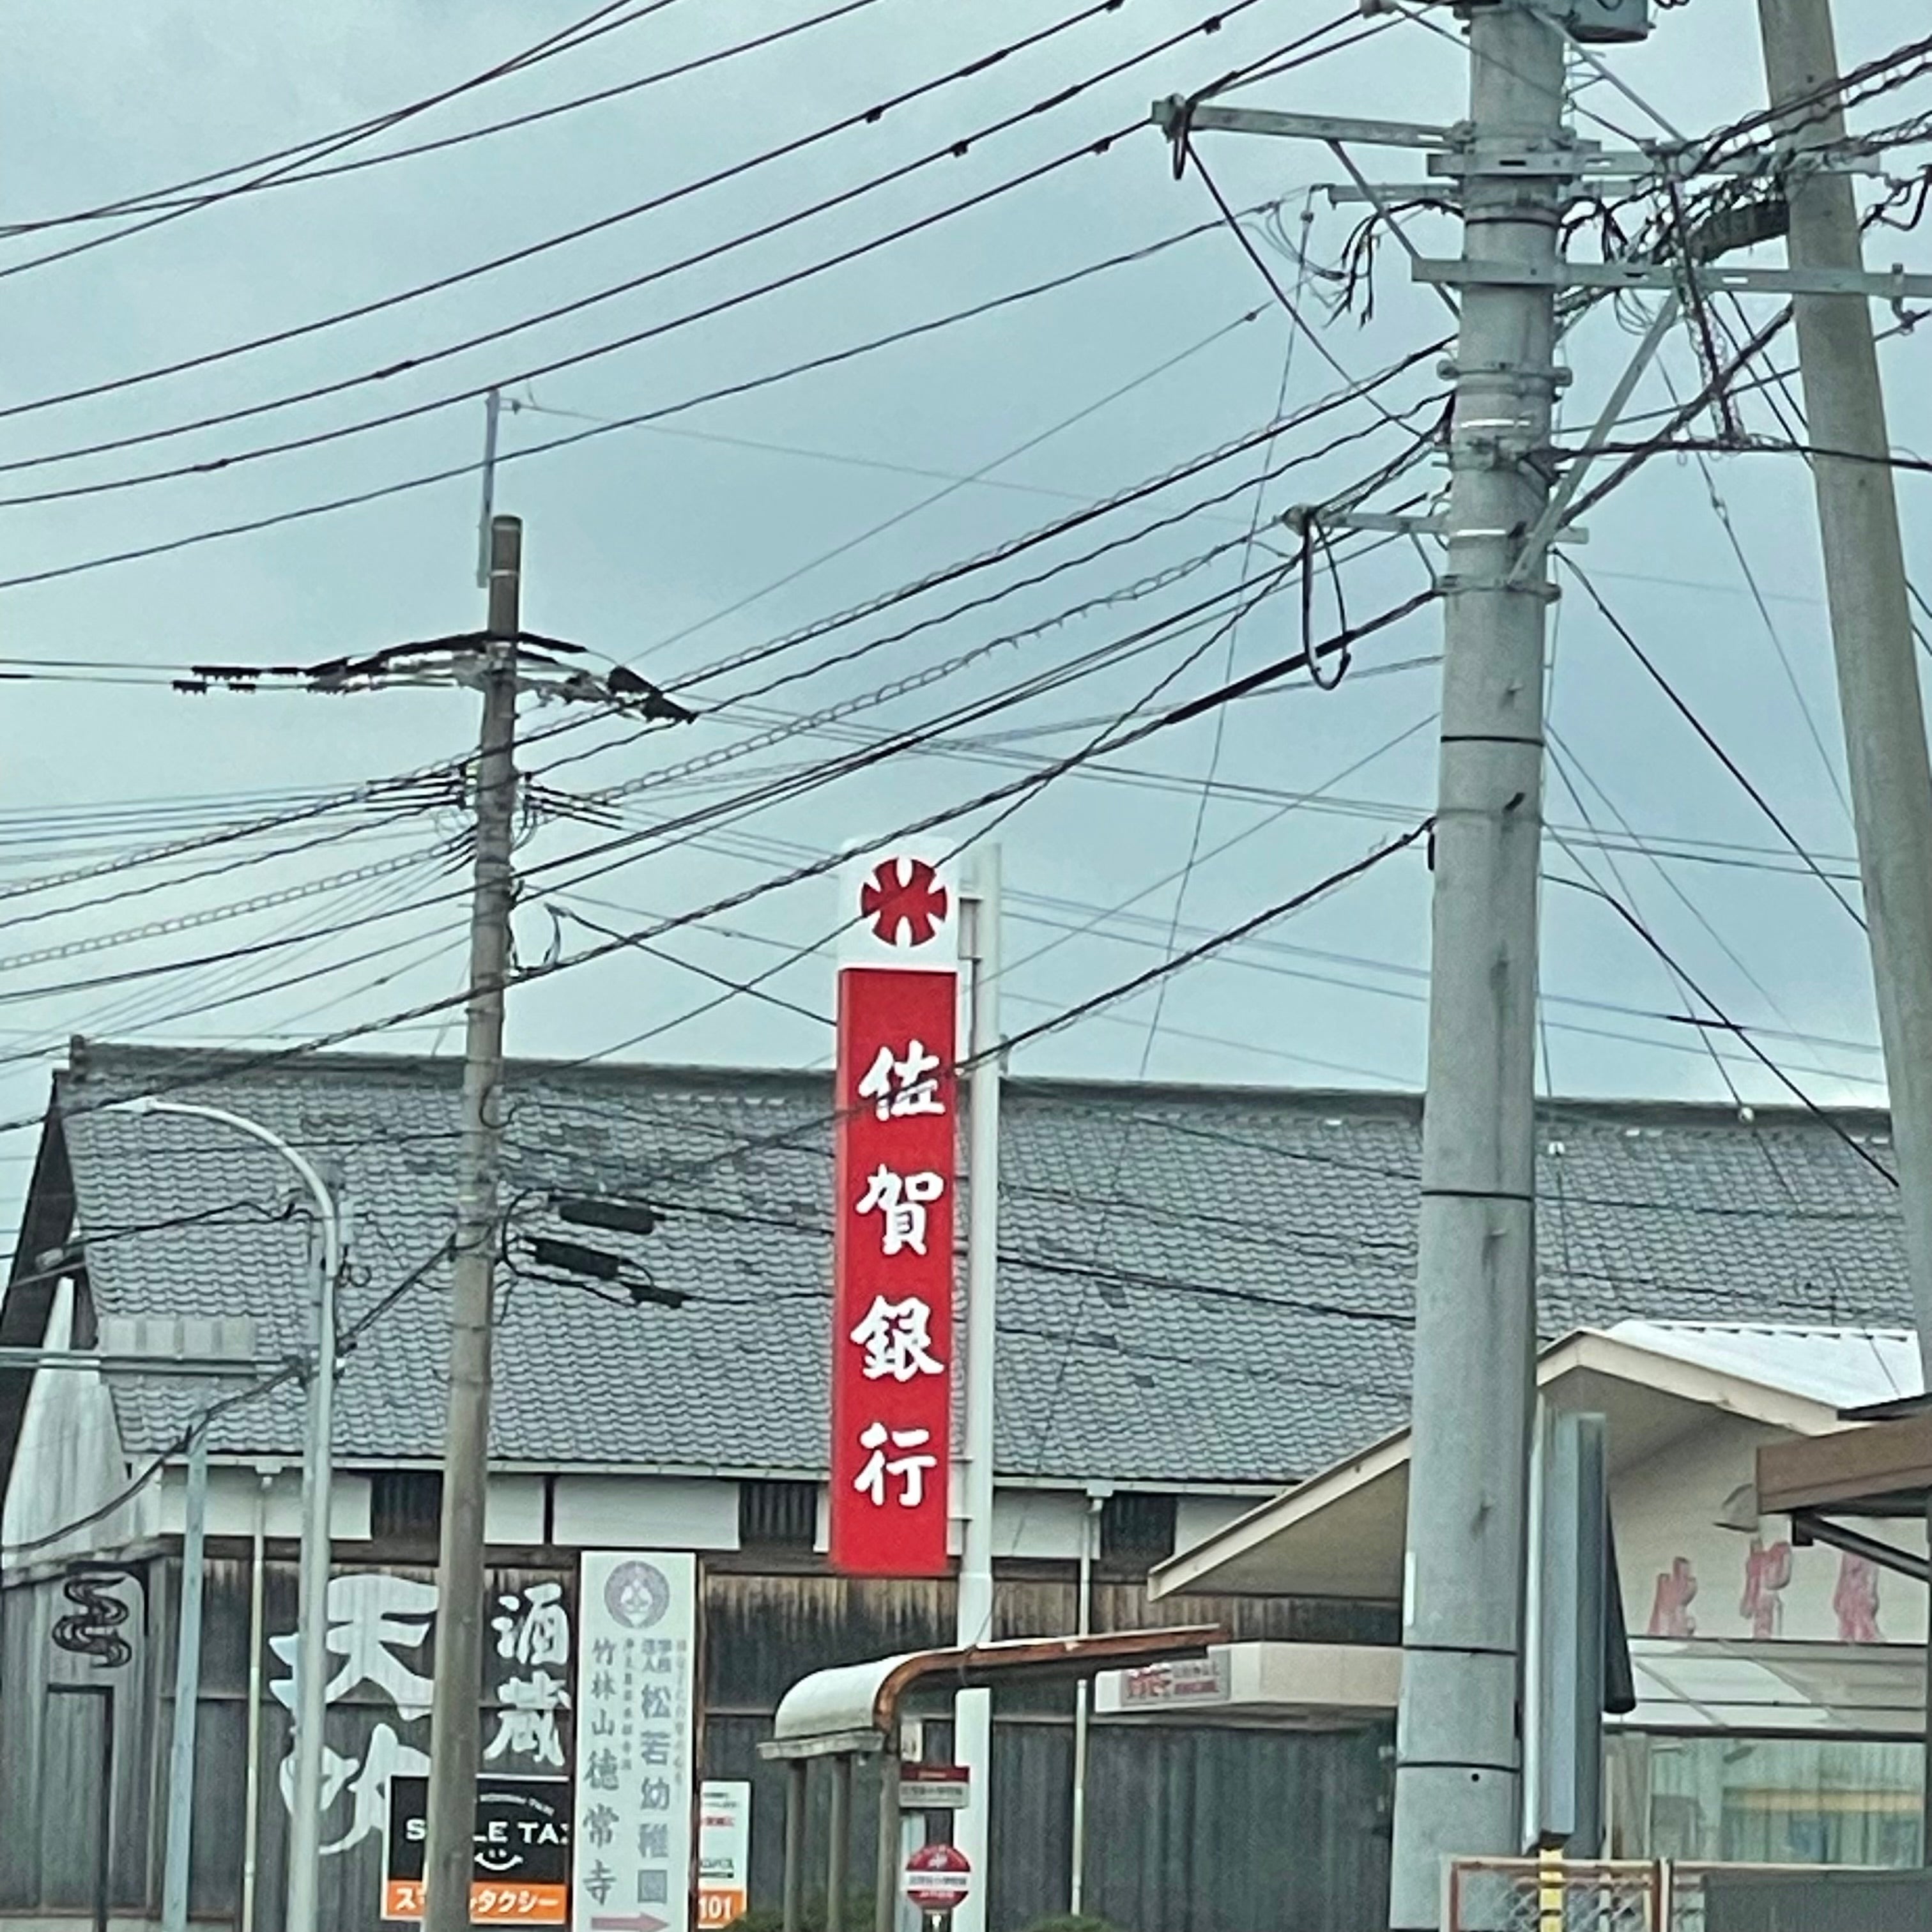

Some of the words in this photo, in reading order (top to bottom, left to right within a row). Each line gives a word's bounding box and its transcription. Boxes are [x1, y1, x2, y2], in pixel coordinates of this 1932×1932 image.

[850, 1039, 946, 1506] 佐賀銀行
[484, 1583, 571, 1767] 酒蔵
